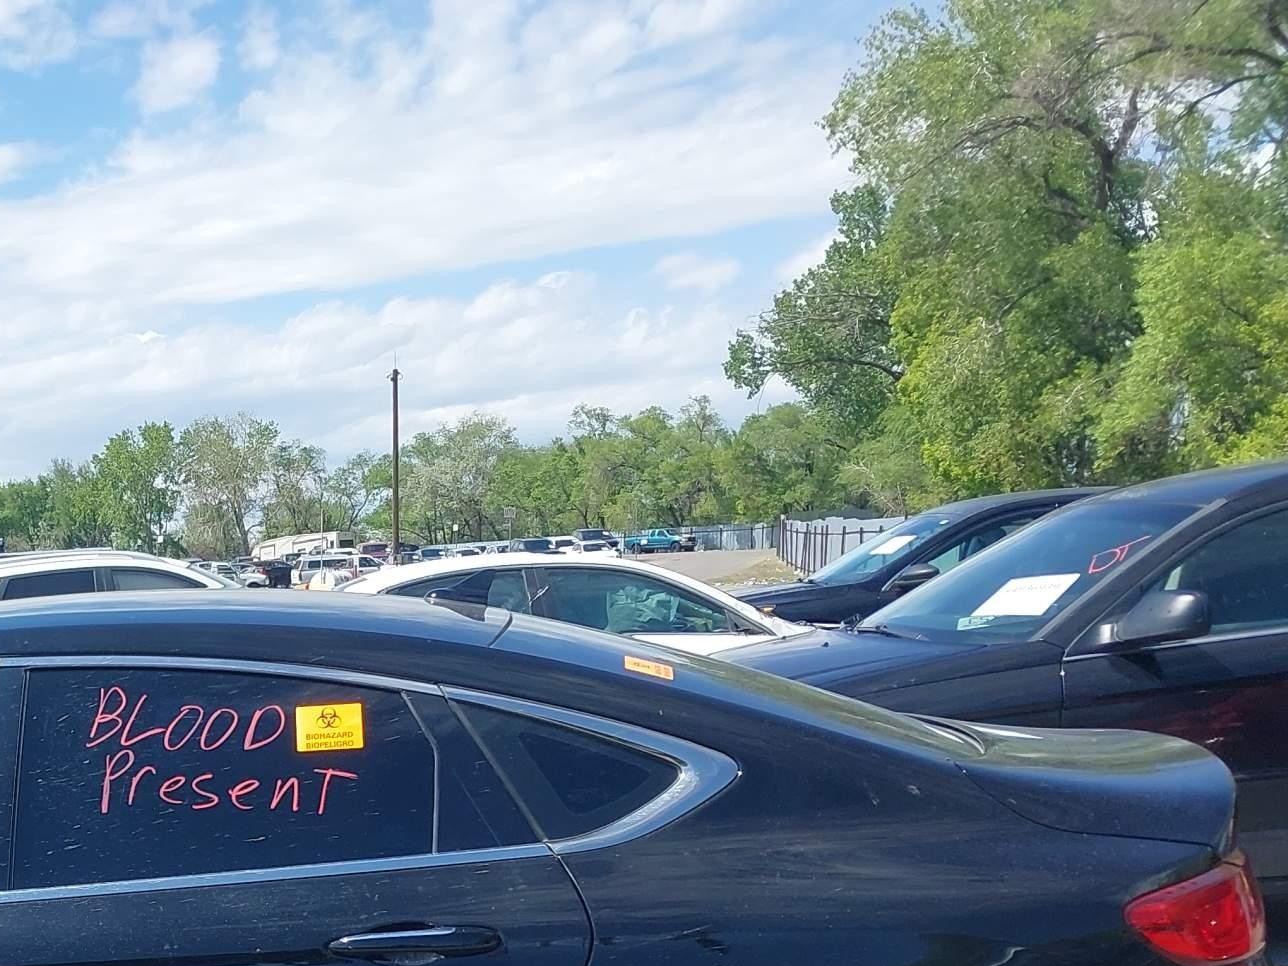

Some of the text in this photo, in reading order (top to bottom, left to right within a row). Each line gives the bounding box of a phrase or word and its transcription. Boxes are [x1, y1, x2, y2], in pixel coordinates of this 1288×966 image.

[86, 686, 286, 751] BLOOD
[305, 731, 354, 741] BIOHAZARD
[305, 740, 354, 749] BIOPELIGRO
